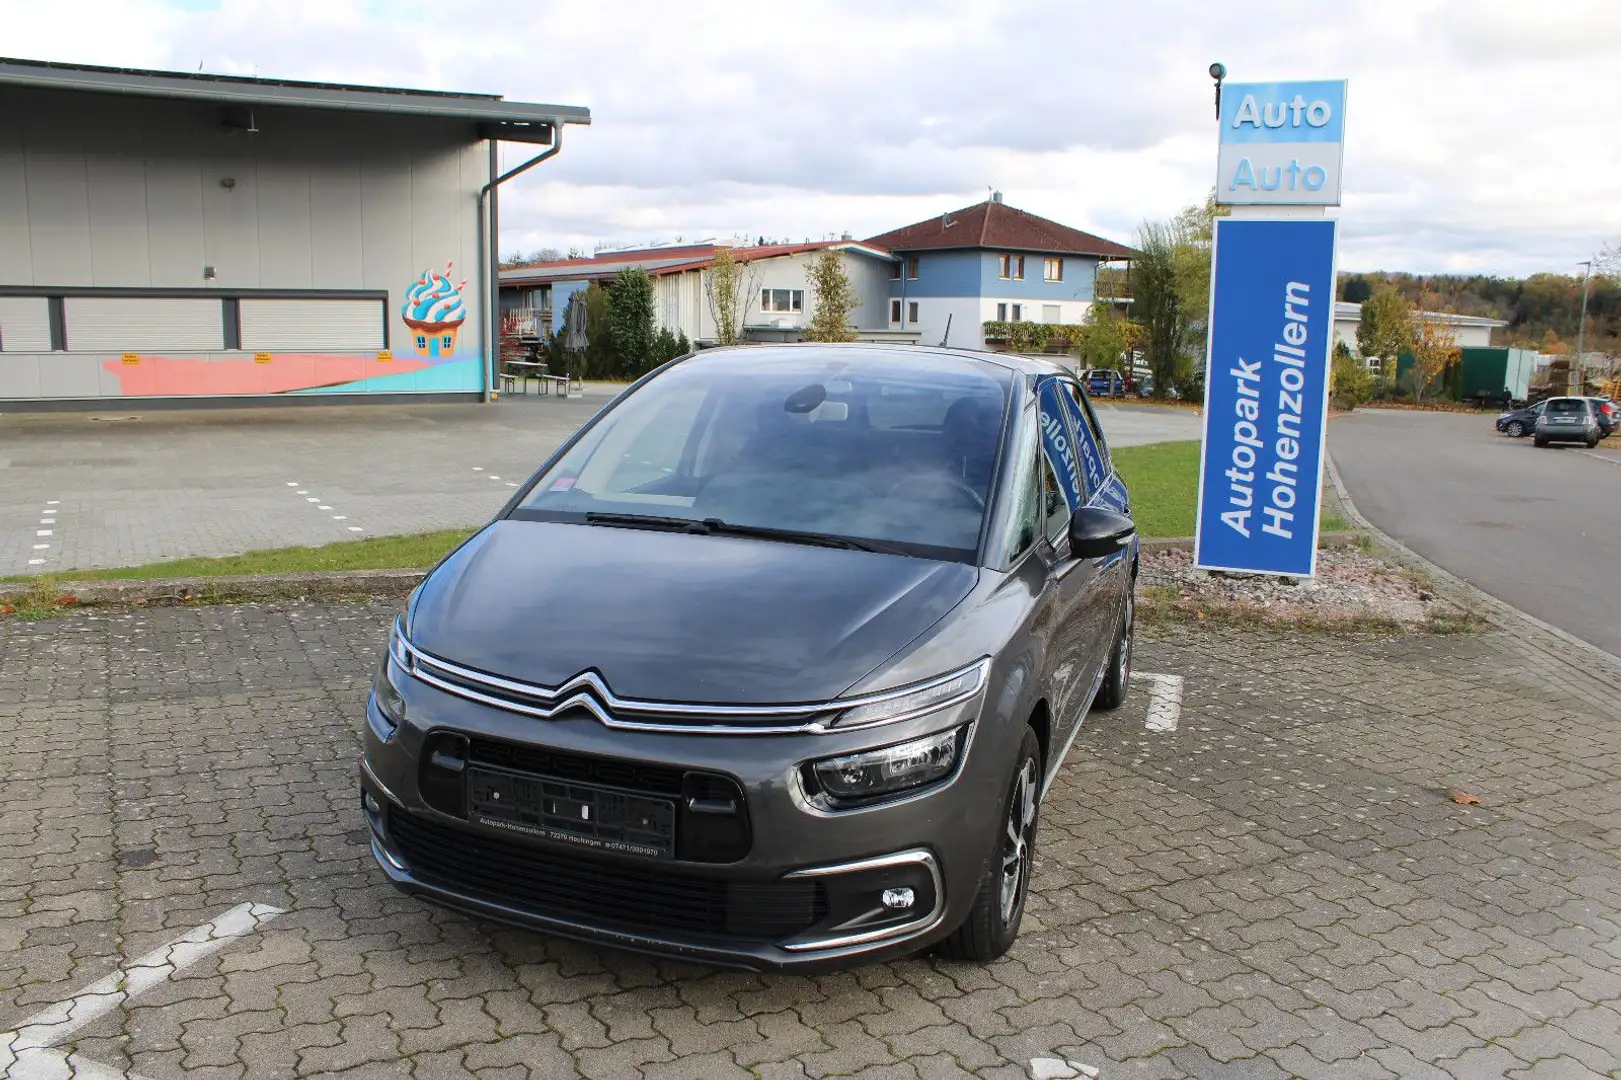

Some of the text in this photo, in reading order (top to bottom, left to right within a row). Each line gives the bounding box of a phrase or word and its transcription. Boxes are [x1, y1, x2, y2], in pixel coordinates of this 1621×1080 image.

[1232, 94, 1332, 129] Auto
[1229, 157, 1328, 192] Auto
[1220, 356, 1263, 539] Autopark
[1261, 280, 1310, 540] Hohenzollern
